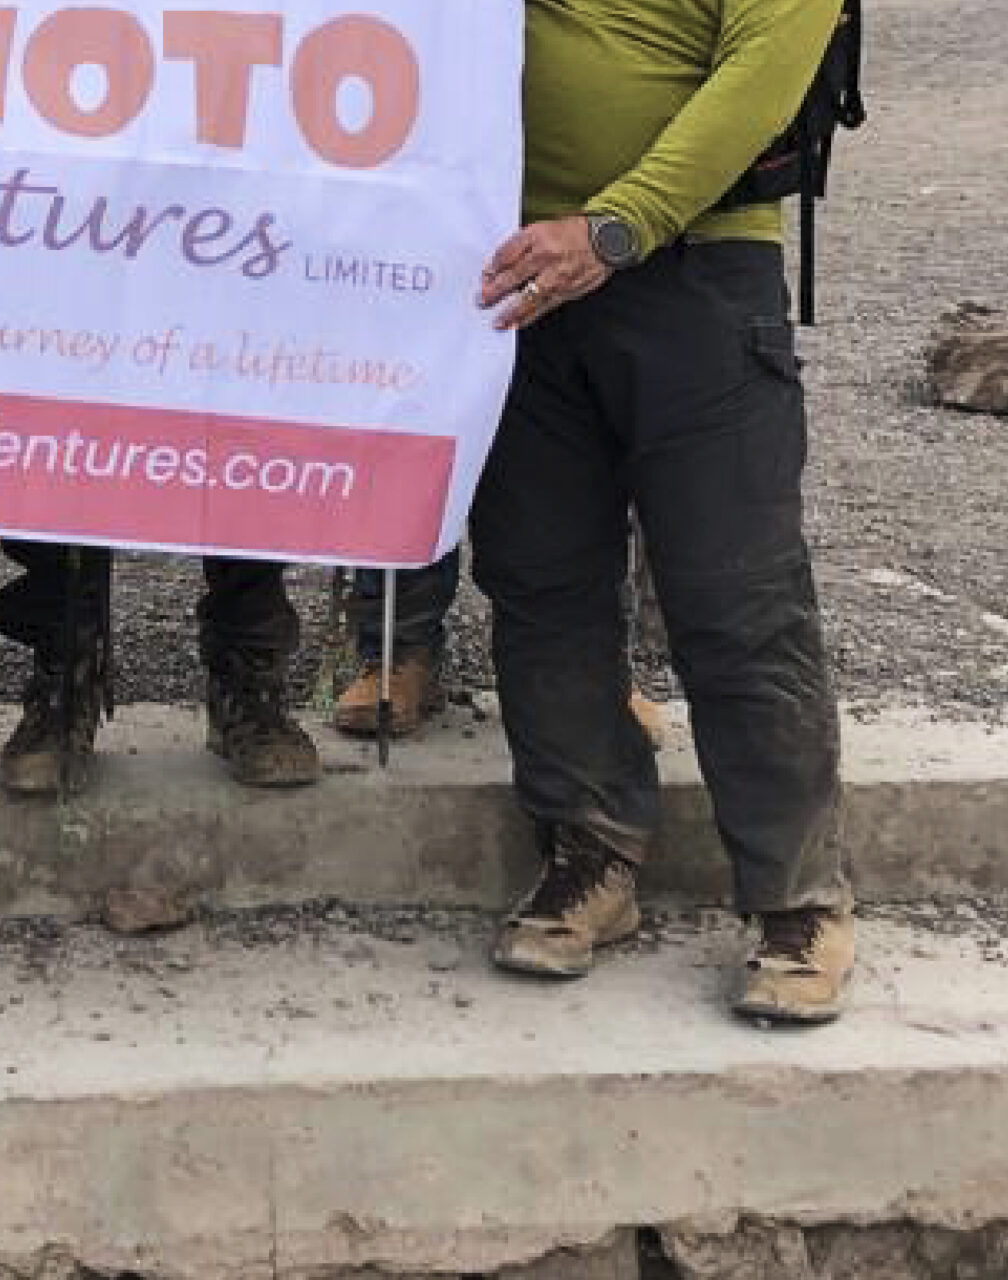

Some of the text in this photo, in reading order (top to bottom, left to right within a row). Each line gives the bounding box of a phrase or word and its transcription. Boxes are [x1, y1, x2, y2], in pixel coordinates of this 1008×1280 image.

[305, 256, 433, 293] LIMITED
[131, 324, 185, 376] of
[189, 337, 222, 371] a
[229, 330, 422, 390] lifetime
